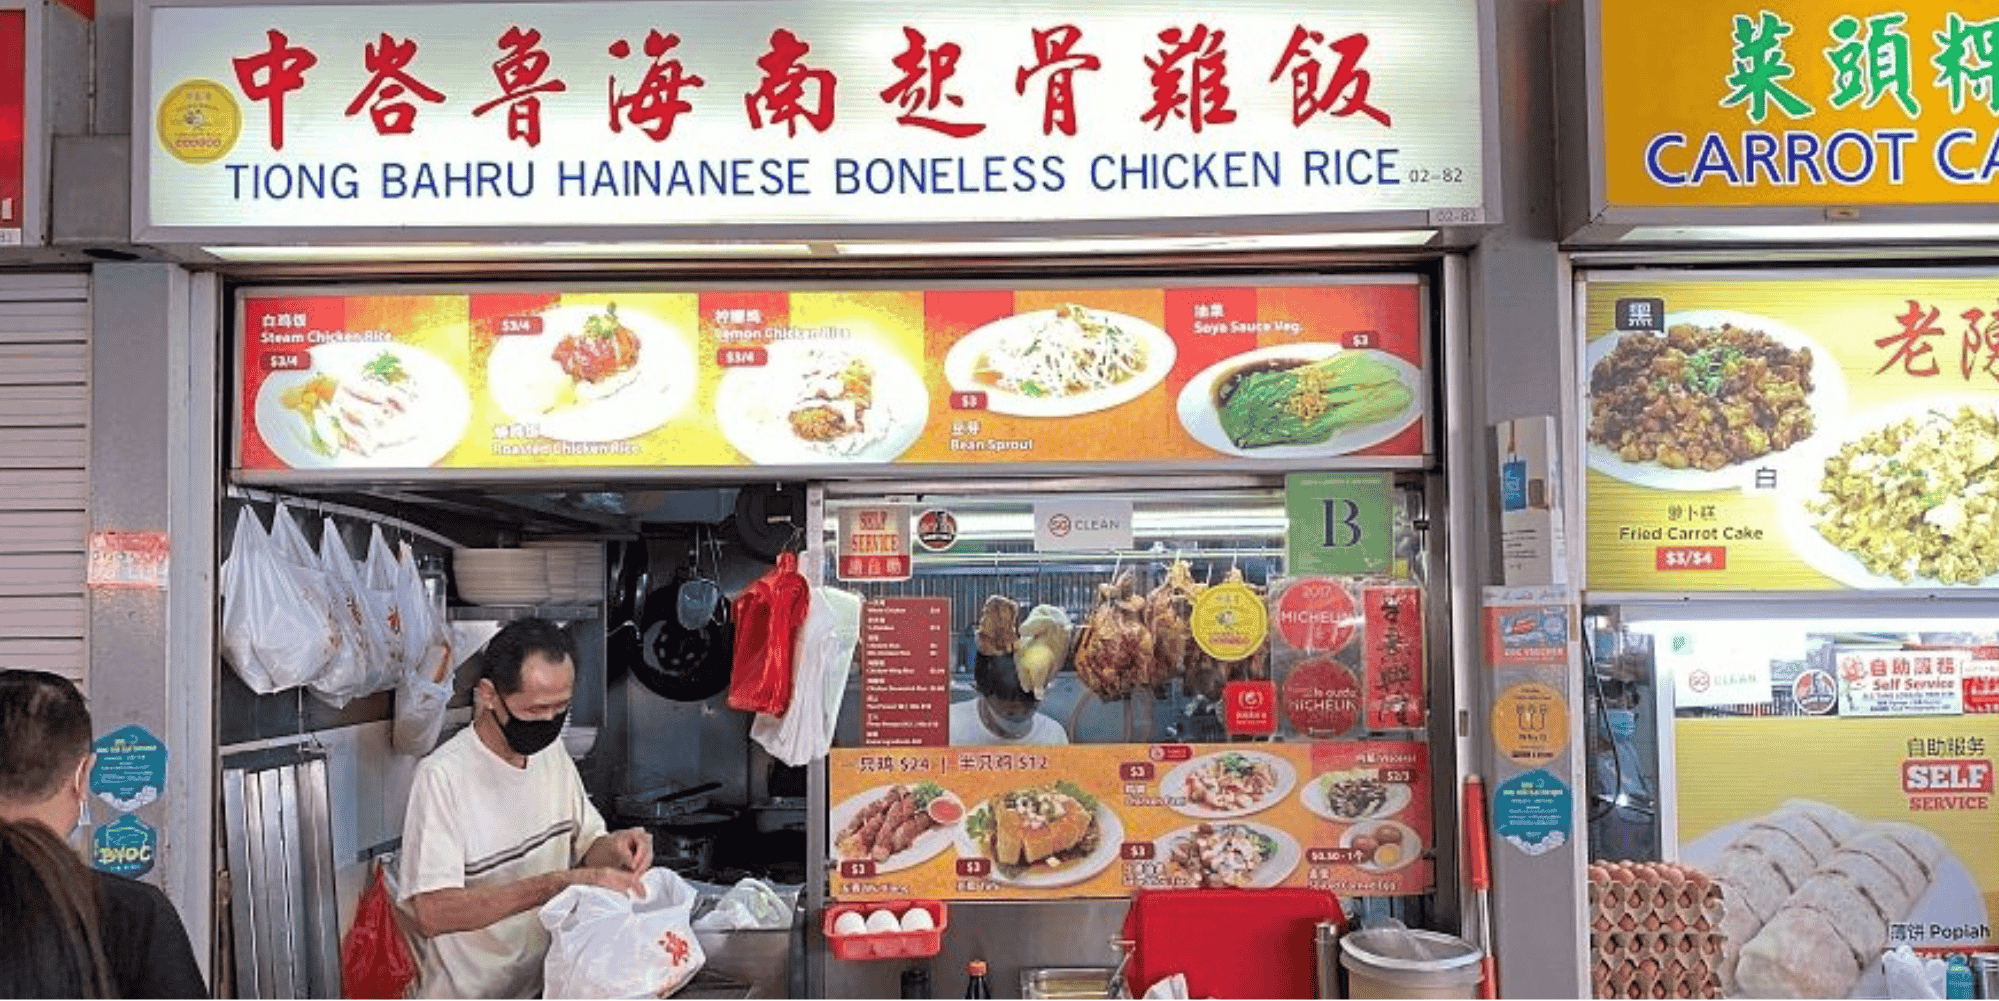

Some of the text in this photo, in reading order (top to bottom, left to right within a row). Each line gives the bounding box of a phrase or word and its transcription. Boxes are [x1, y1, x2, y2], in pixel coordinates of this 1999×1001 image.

[1646, 131, 1915, 186] CARROT
[225, 148, 1401, 200] TIONG BAHRU HAINANESE BONELESS CHICKEN RICE
[1408, 166, 1463, 184] 02-82
[1194, 320, 1228, 335] Soya
[1231, 320, 1271, 333] Sauce
[260, 332, 304, 343] Steam
[307, 330, 361, 343] Chicken
[951, 438, 1033, 452] Bean Sprout
[1755, 467, 1777, 489] 白
[1075, 519, 1119, 530] CLEAN
[1323, 498, 1361, 547] B
[1619, 525, 1764, 541] Fried Carrot Cake
[1665, 550, 1713, 567] $3/$4
[1872, 675, 1955, 691] Self Service
[1907, 736, 1985, 757] 自助服务
[901, 756, 930, 771] $24
[1019, 755, 1047, 770] $12
[1130, 766, 1145, 777] $3
[1906, 764, 1989, 789] SELF
[1909, 796, 1988, 811] SERVICE
[1131, 845, 1146, 857] $3
[852, 864, 866, 875] $3
[967, 862, 981, 874] $3
[1929, 923, 1991, 941] Popiah
